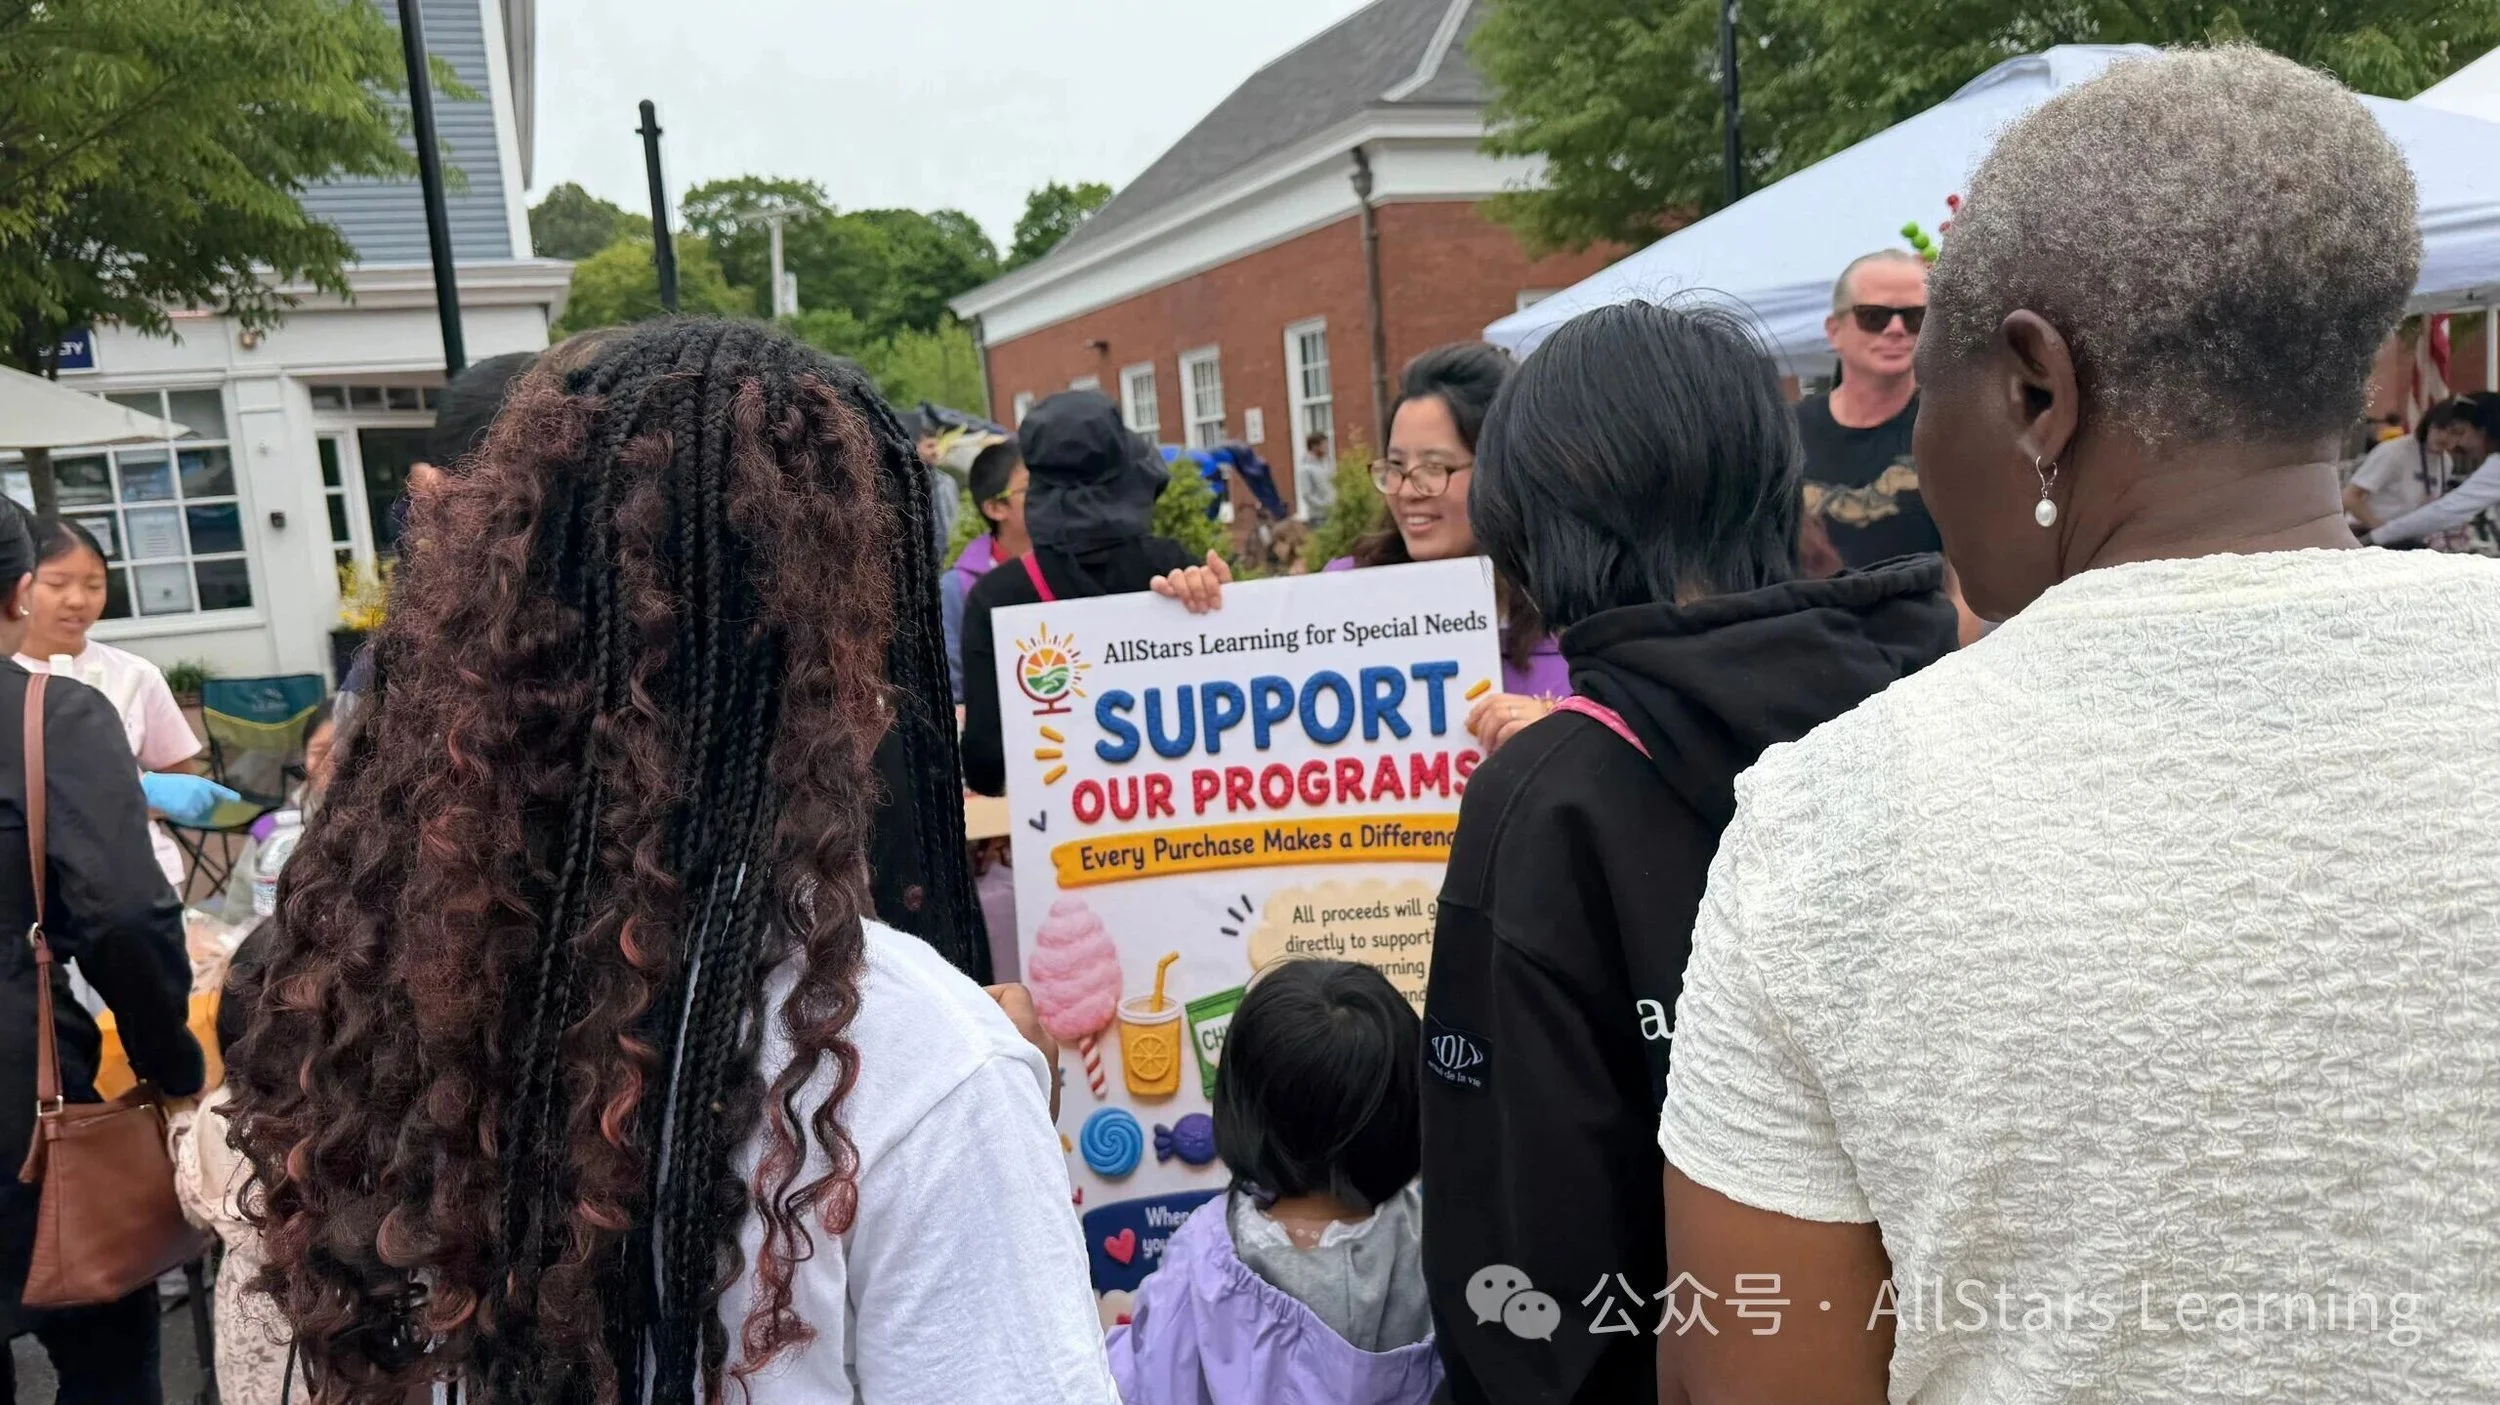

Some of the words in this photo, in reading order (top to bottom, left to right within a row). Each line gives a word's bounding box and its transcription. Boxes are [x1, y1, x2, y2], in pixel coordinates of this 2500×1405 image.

[1103, 639, 1194, 664] AllStars
[1199, 628, 1299, 653] Learning
[1305, 624, 1336, 645] for
[1343, 615, 1418, 648] Special
[1424, 610, 1487, 635] Needs
[1094, 661, 1459, 763] SUPPORT
[1072, 772, 1175, 825] OUR
[1192, 749, 1481, 815] PROGRAMS
[1081, 846, 1144, 871] Every
[1154, 833, 1255, 862] Purchase
[1263, 827, 1332, 852] Makes
[1340, 833, 1353, 848] a
[1292, 905, 1315, 923] All
[1322, 900, 1390, 927] proceeds
[1395, 899, 1422, 917] will
[1285, 932, 1345, 955] directly
[1350, 933, 1366, 948] to
[1375, 957, 1425, 979] arning
